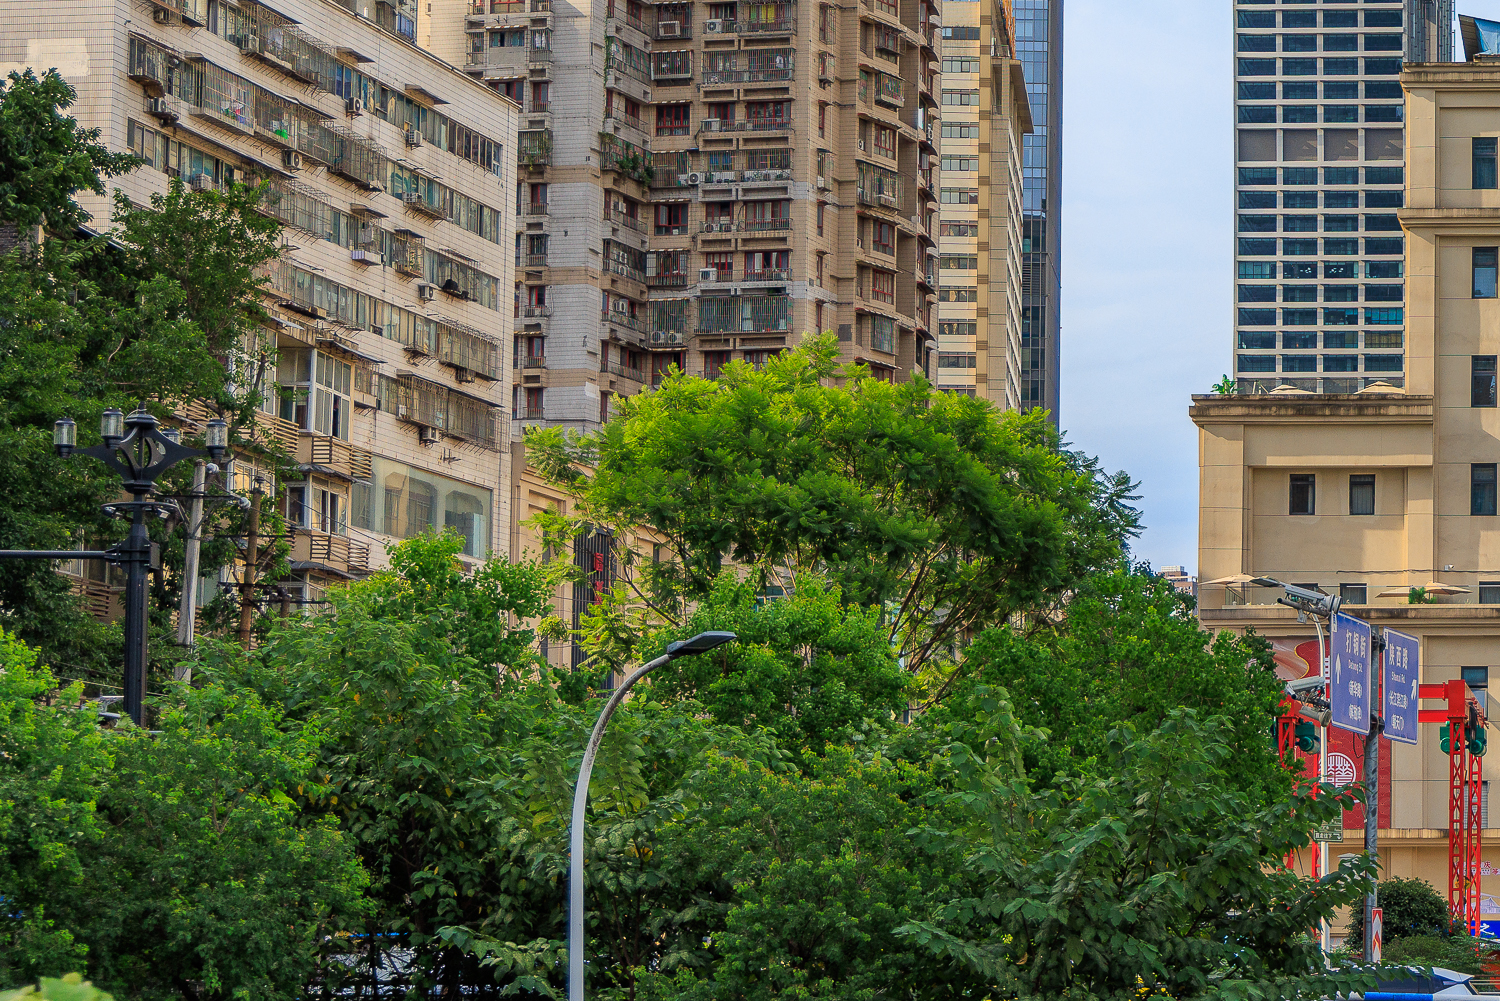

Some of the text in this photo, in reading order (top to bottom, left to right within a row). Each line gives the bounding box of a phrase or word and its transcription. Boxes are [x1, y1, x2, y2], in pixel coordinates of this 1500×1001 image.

[1345, 629, 1366, 659] 打铜街
[1388, 643, 1408, 670] 陕西路
